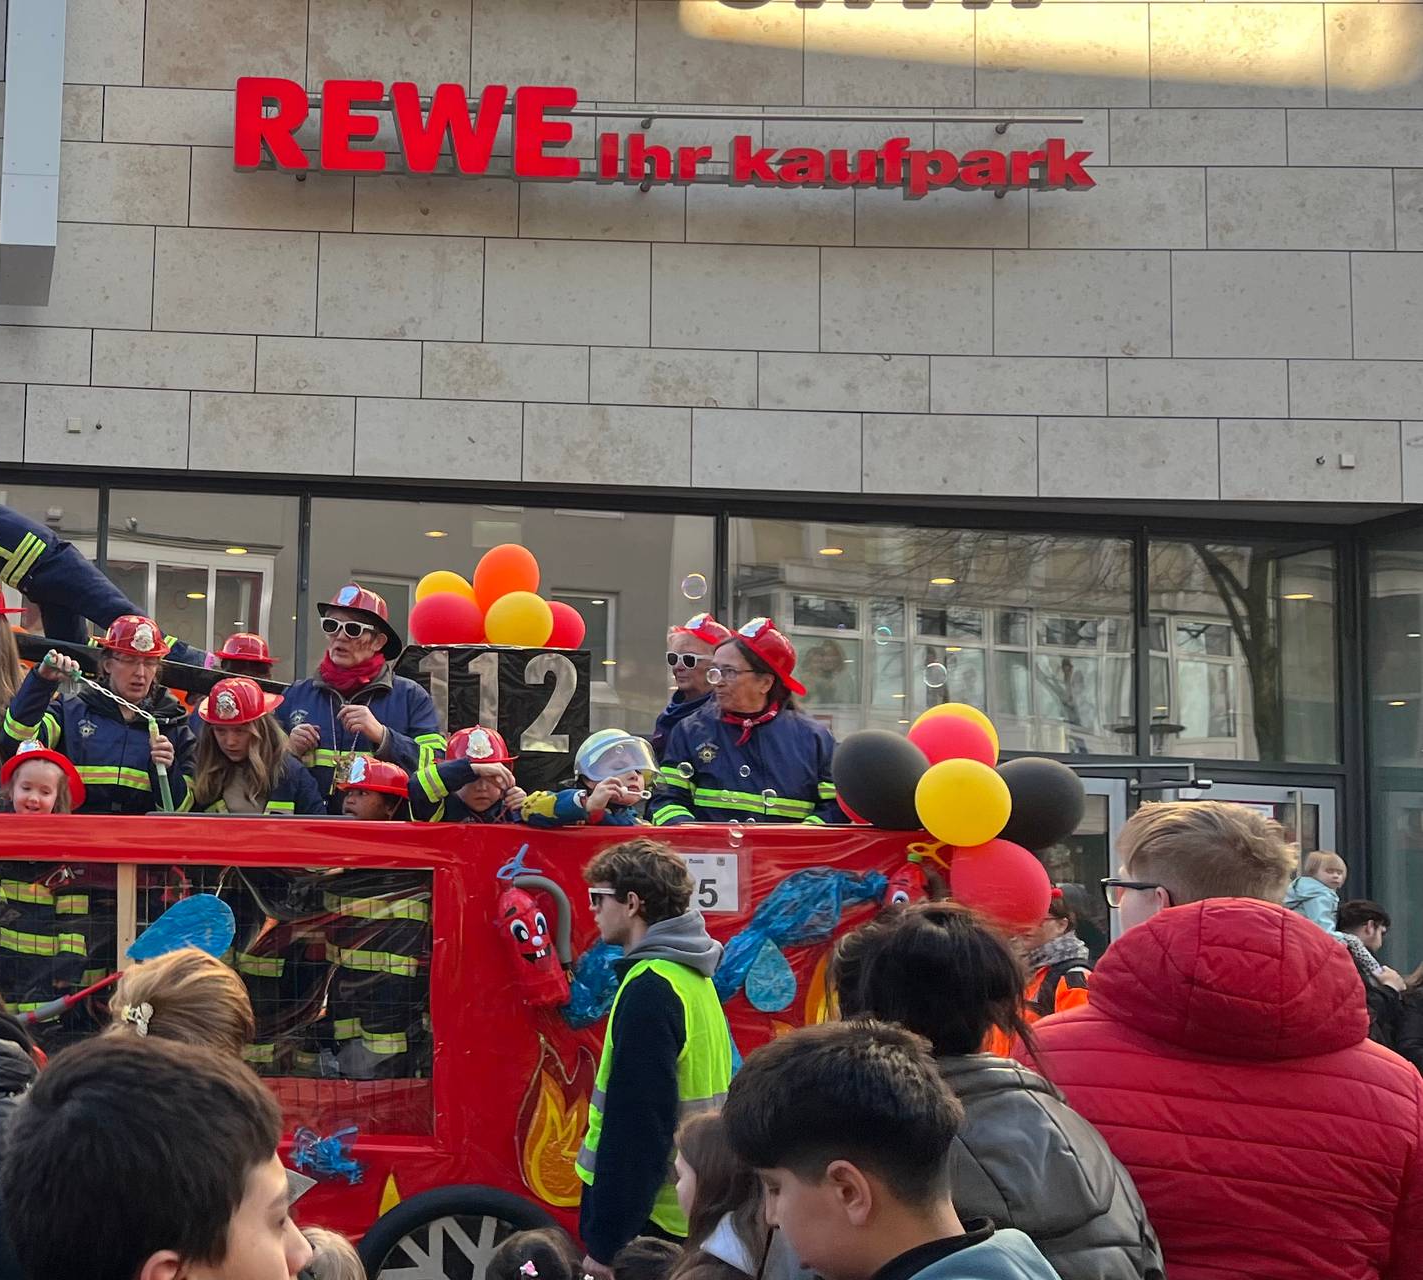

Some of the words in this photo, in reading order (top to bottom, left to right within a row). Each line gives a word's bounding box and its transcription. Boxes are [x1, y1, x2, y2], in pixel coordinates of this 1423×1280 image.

[233, 76, 581, 181] REWE
[599, 132, 714, 184] Ihr
[733, 135, 1097, 199] kaufpark
[419, 650, 577, 753] 112
